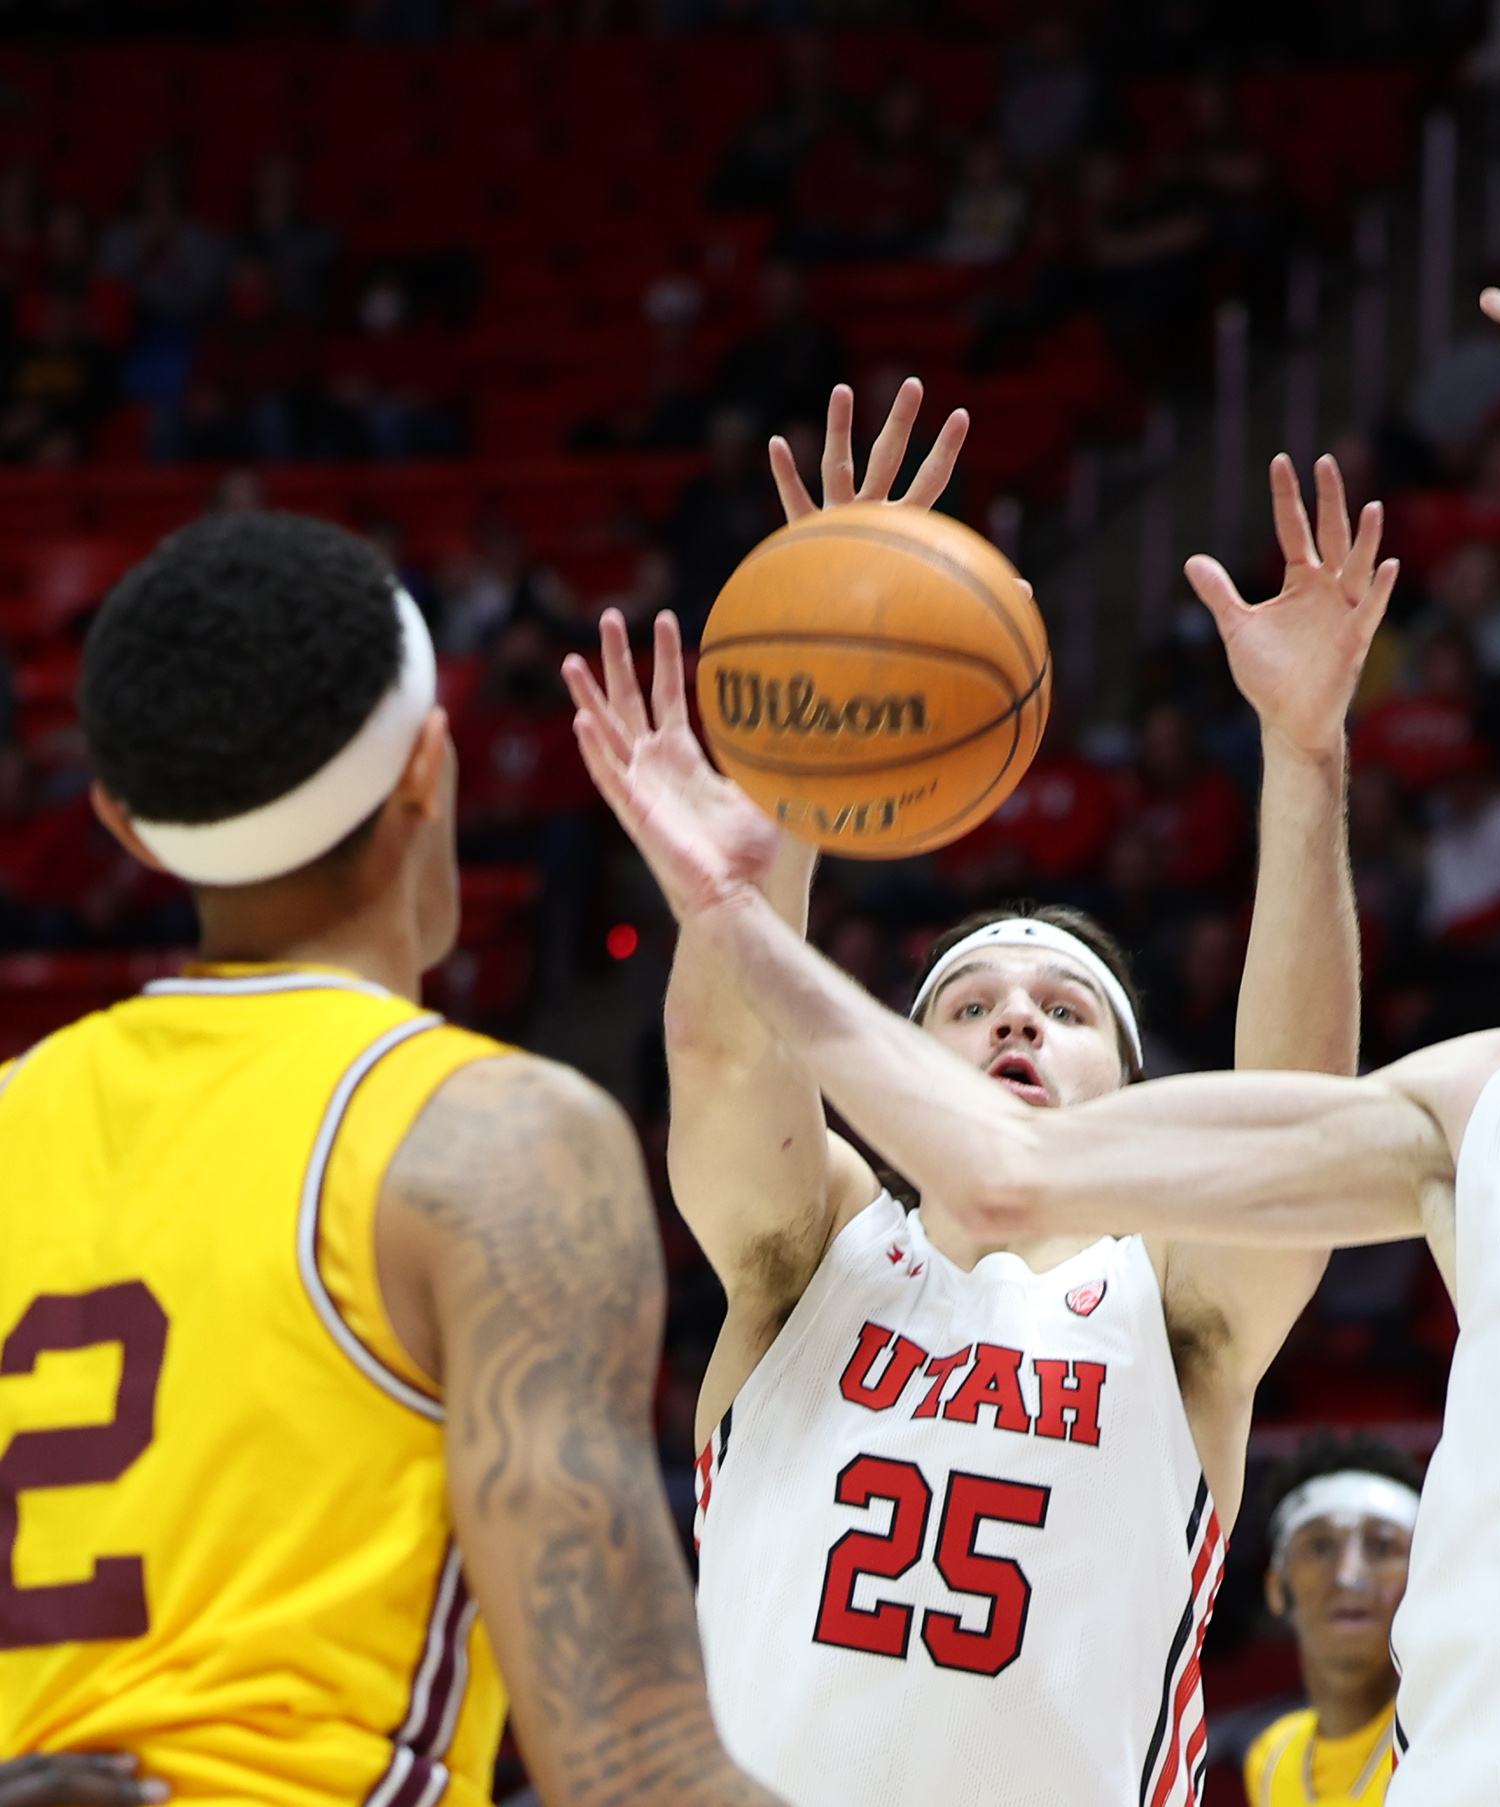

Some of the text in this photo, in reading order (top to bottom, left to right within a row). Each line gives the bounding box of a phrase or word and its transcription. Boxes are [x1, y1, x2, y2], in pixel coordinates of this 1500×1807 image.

[715, 666, 930, 736] Wilson
[0, 1278, 170, 1651] 2
[839, 1321, 1106, 1447] UTAH
[812, 1453, 1052, 1678] 25
